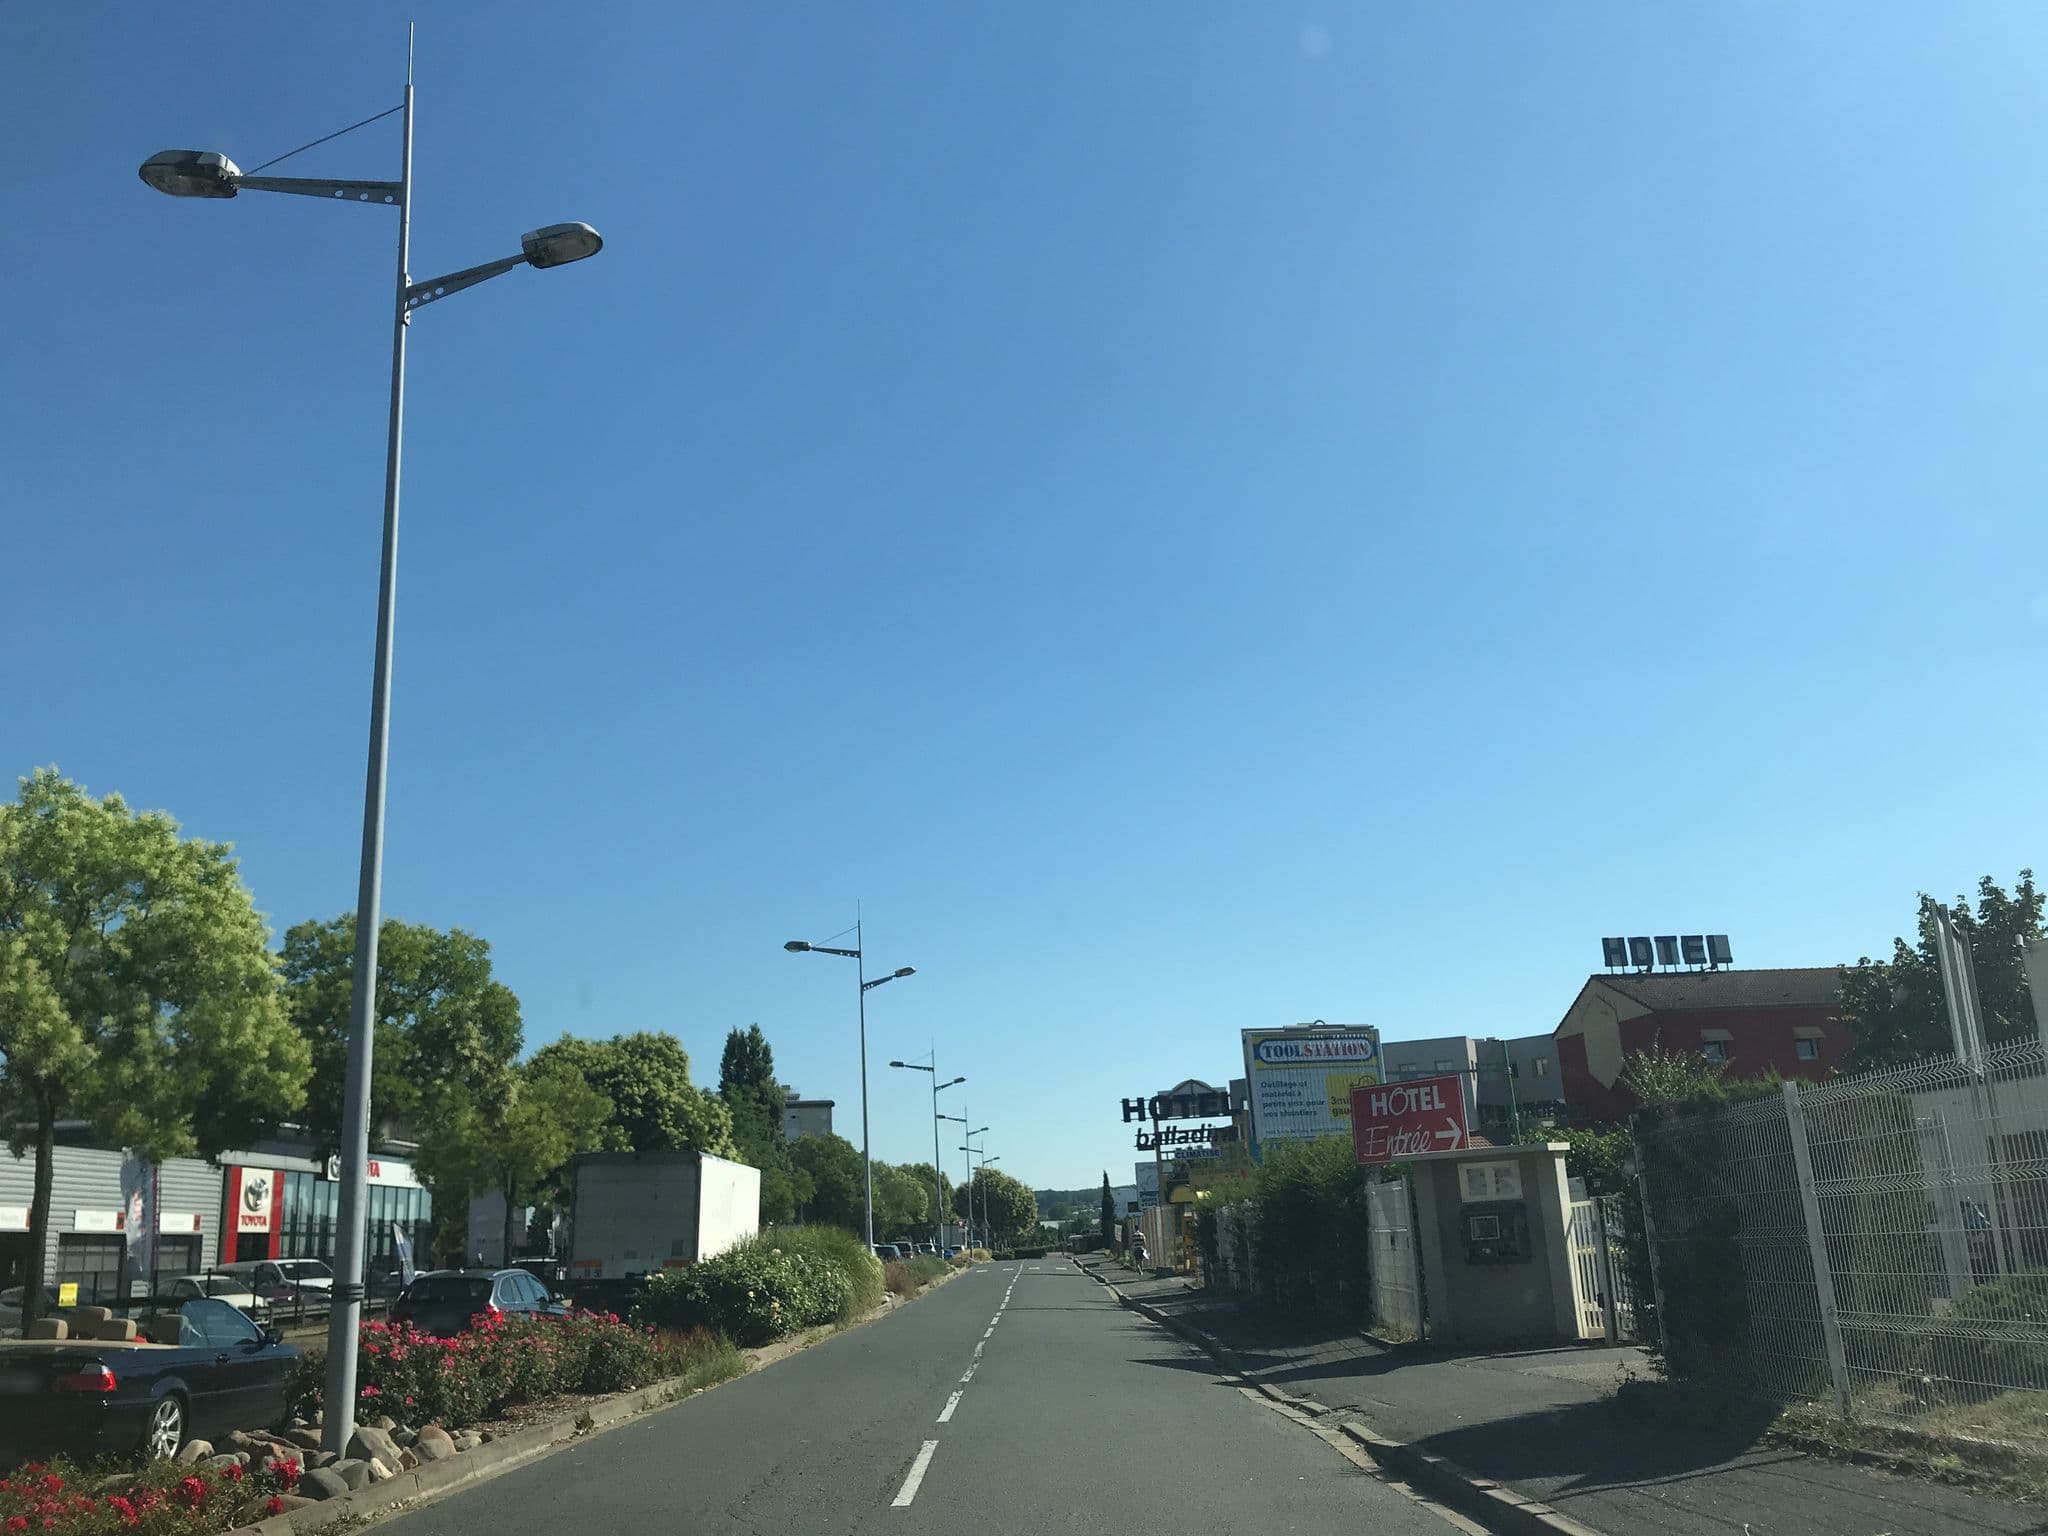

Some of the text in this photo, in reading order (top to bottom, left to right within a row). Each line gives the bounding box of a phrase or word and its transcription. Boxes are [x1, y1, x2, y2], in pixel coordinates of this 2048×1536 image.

[1602, 935, 1733, 966] HOTEL
[1262, 1042, 1369, 1058] TOOLSTATION
[1331, 1096, 1351, 1105] 3mi
[1364, 1124, 1432, 1156] Entrée
[240, 1215, 268, 1227] TOYOTA
